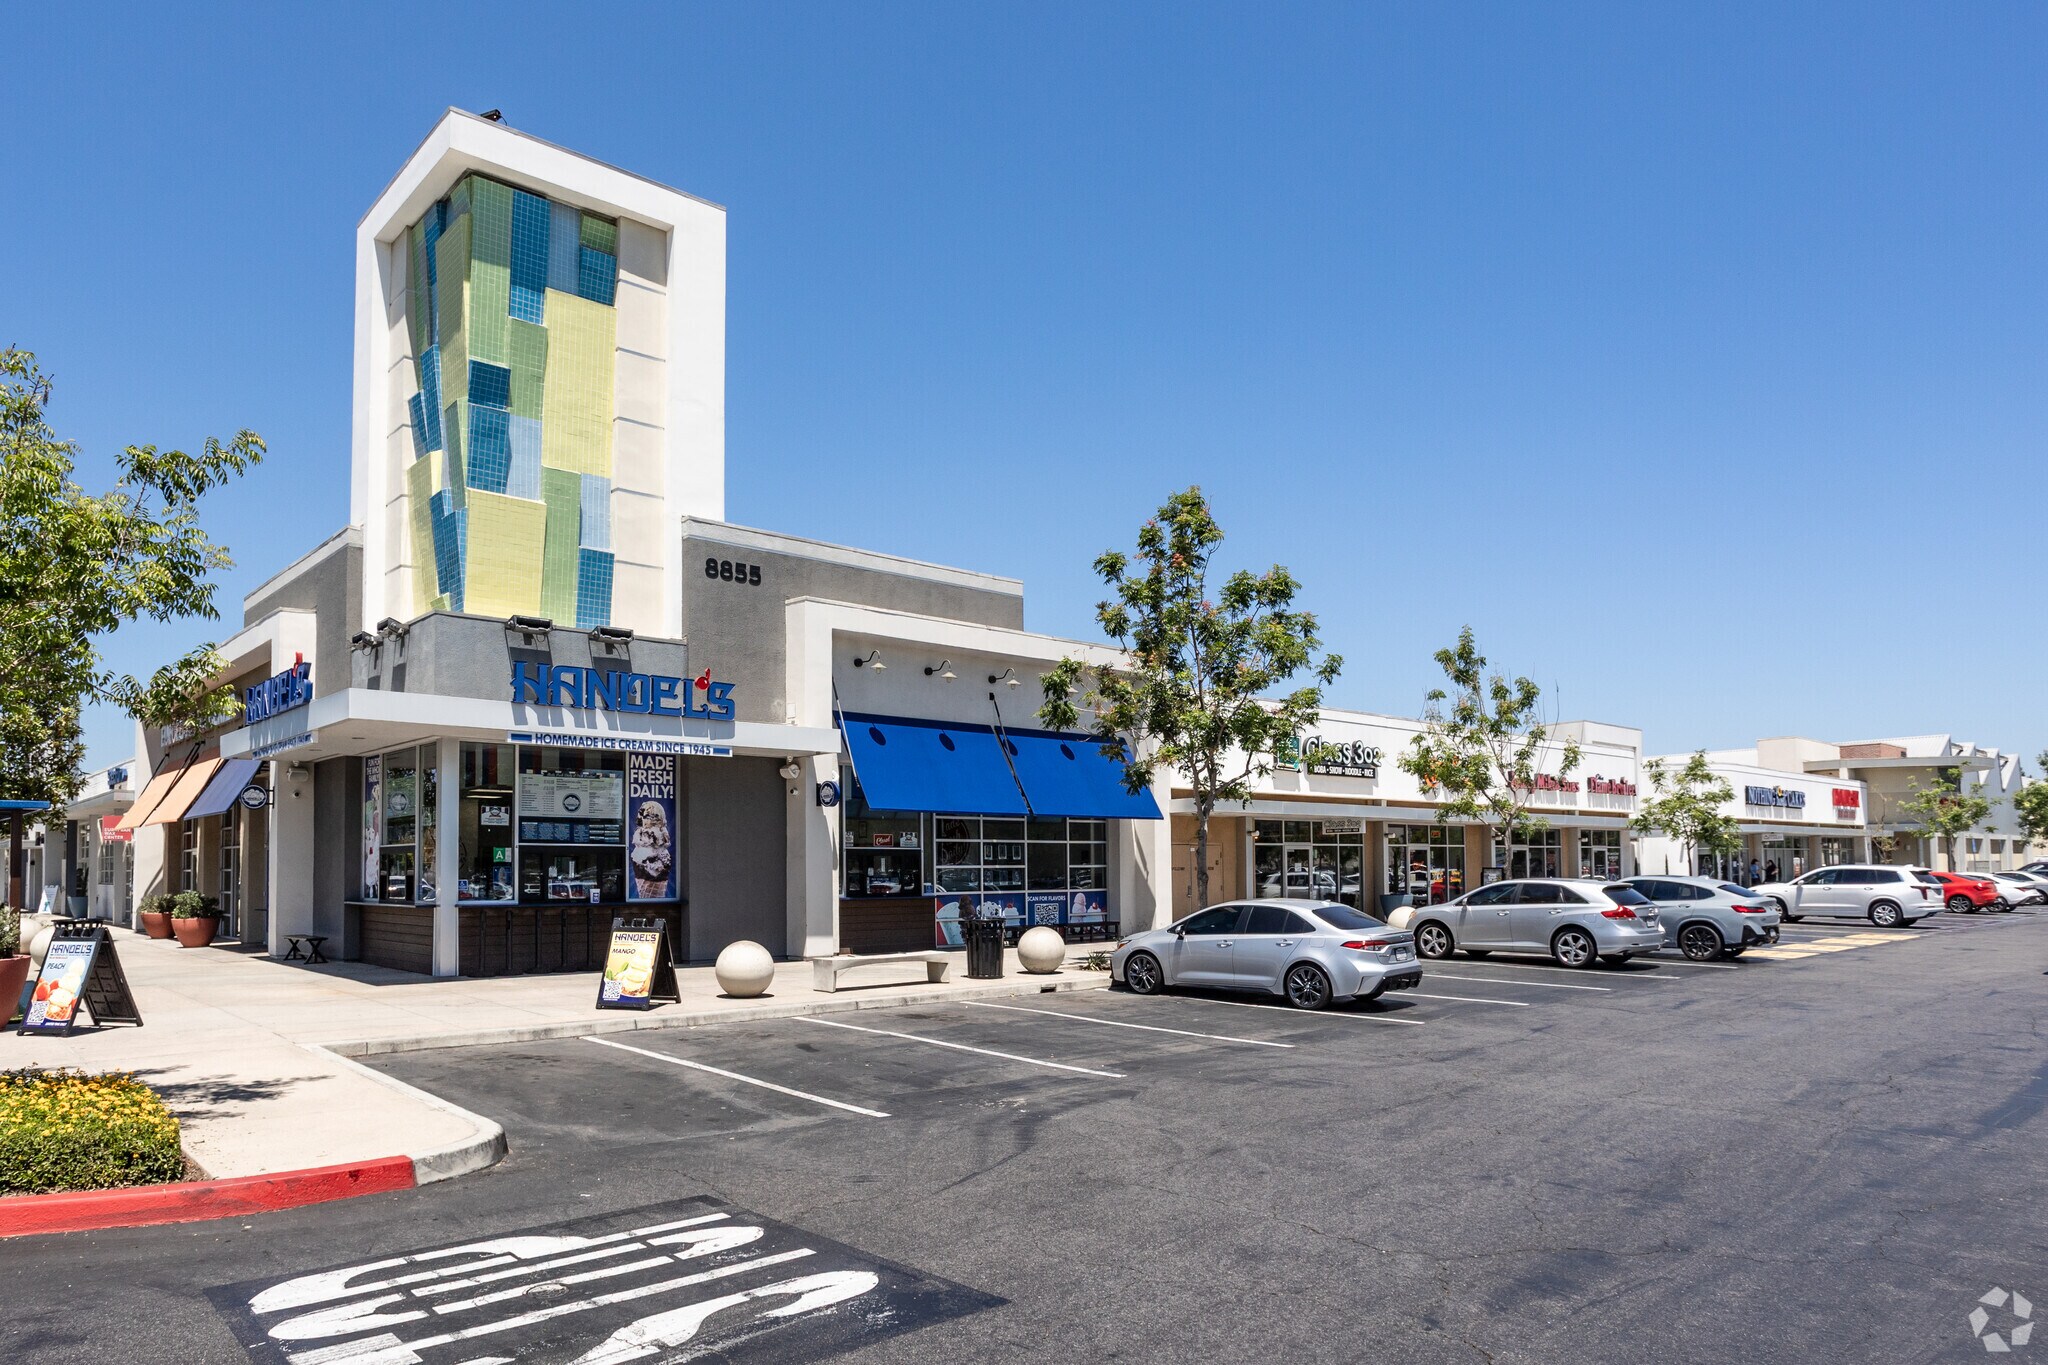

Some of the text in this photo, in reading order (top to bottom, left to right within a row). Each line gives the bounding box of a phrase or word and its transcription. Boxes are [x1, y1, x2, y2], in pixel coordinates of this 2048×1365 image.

[704, 557, 762, 587] 8855
[245, 652, 314, 726] HANDEL'S
[509, 660, 737, 722] HANDEL'S
[534, 733, 712, 756] HOMEMADE ICE CREAM SINCE 1945
[1352, 739, 1382, 767] 302
[629, 754, 674, 770] MADE
[629, 769, 674, 786] FRESH
[1329, 766, 1343, 775] SNOW
[1345, 767, 1363, 777] NOODLE
[1364, 768, 1374, 777] RICE
[629, 783, 675, 799] DAILY!
[496, 850, 504, 860] A
[614, 933, 657, 941] HANDEL'S
[50, 944, 93, 954] HANDEL'S
[46, 962, 67, 970] PEACH
